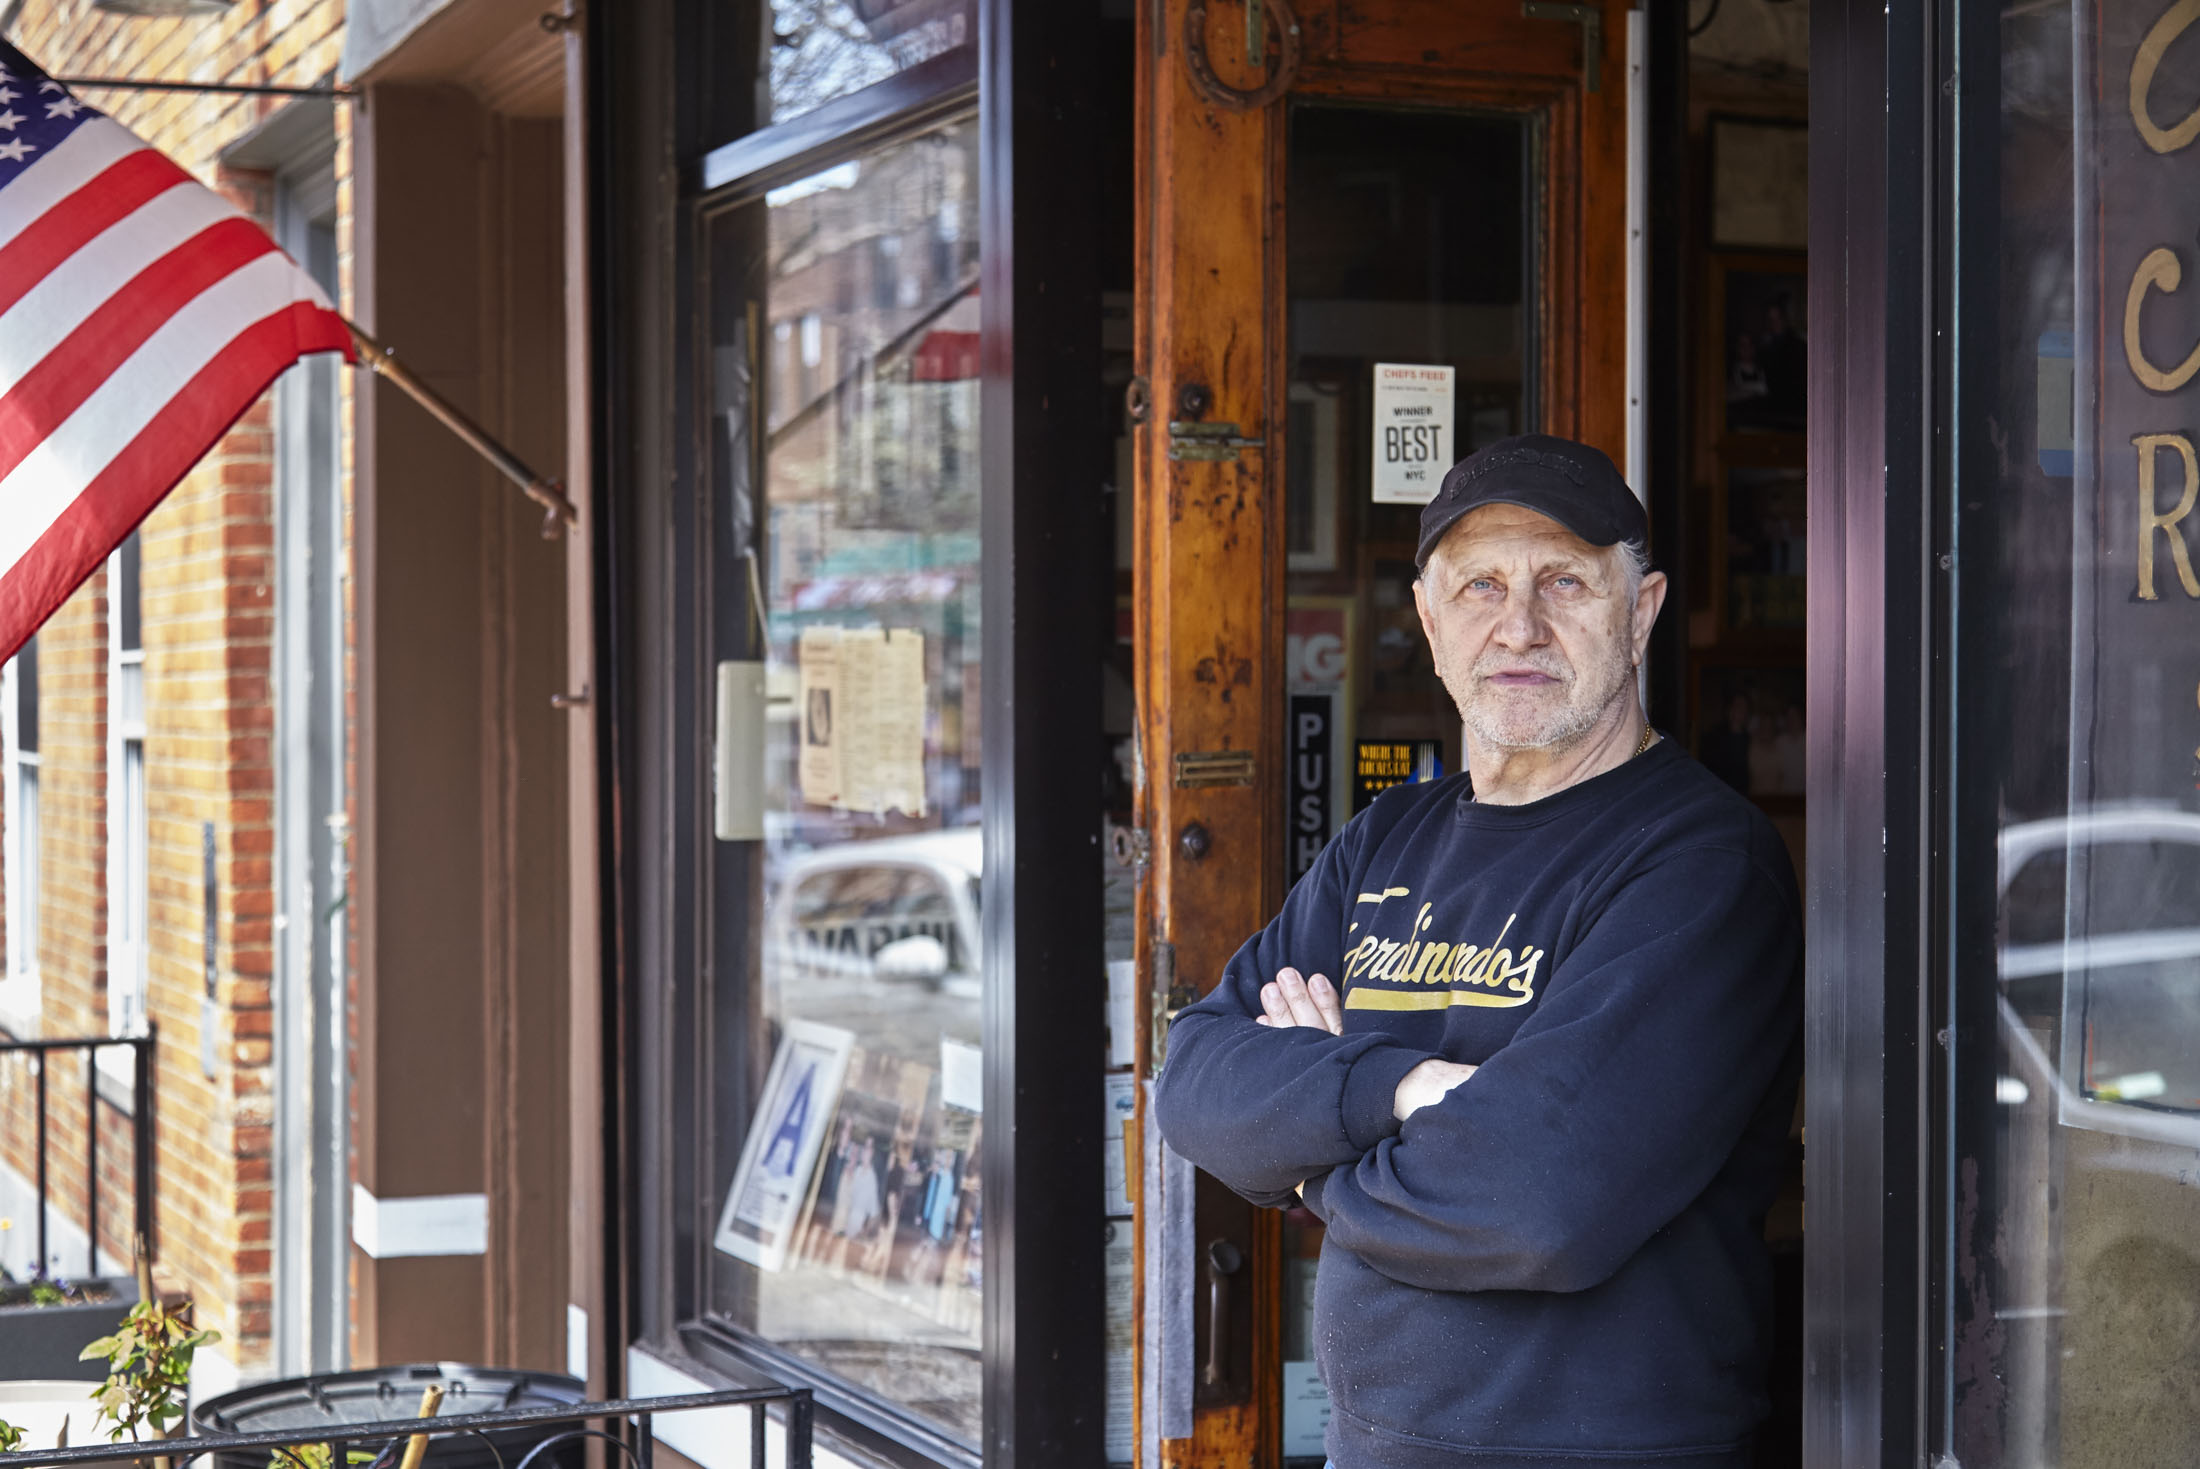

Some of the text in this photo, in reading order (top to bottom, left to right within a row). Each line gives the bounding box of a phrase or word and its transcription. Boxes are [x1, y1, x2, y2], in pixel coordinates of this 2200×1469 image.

[1384, 368, 1447, 382] CHEFS FEED
[1393, 406, 1433, 417] WINNER
[1386, 425, 1441, 463] BEST
[1404, 470, 1426, 482] NYC
[1298, 713, 1323, 872] PUSH
[762, 1061, 818, 1178] A
